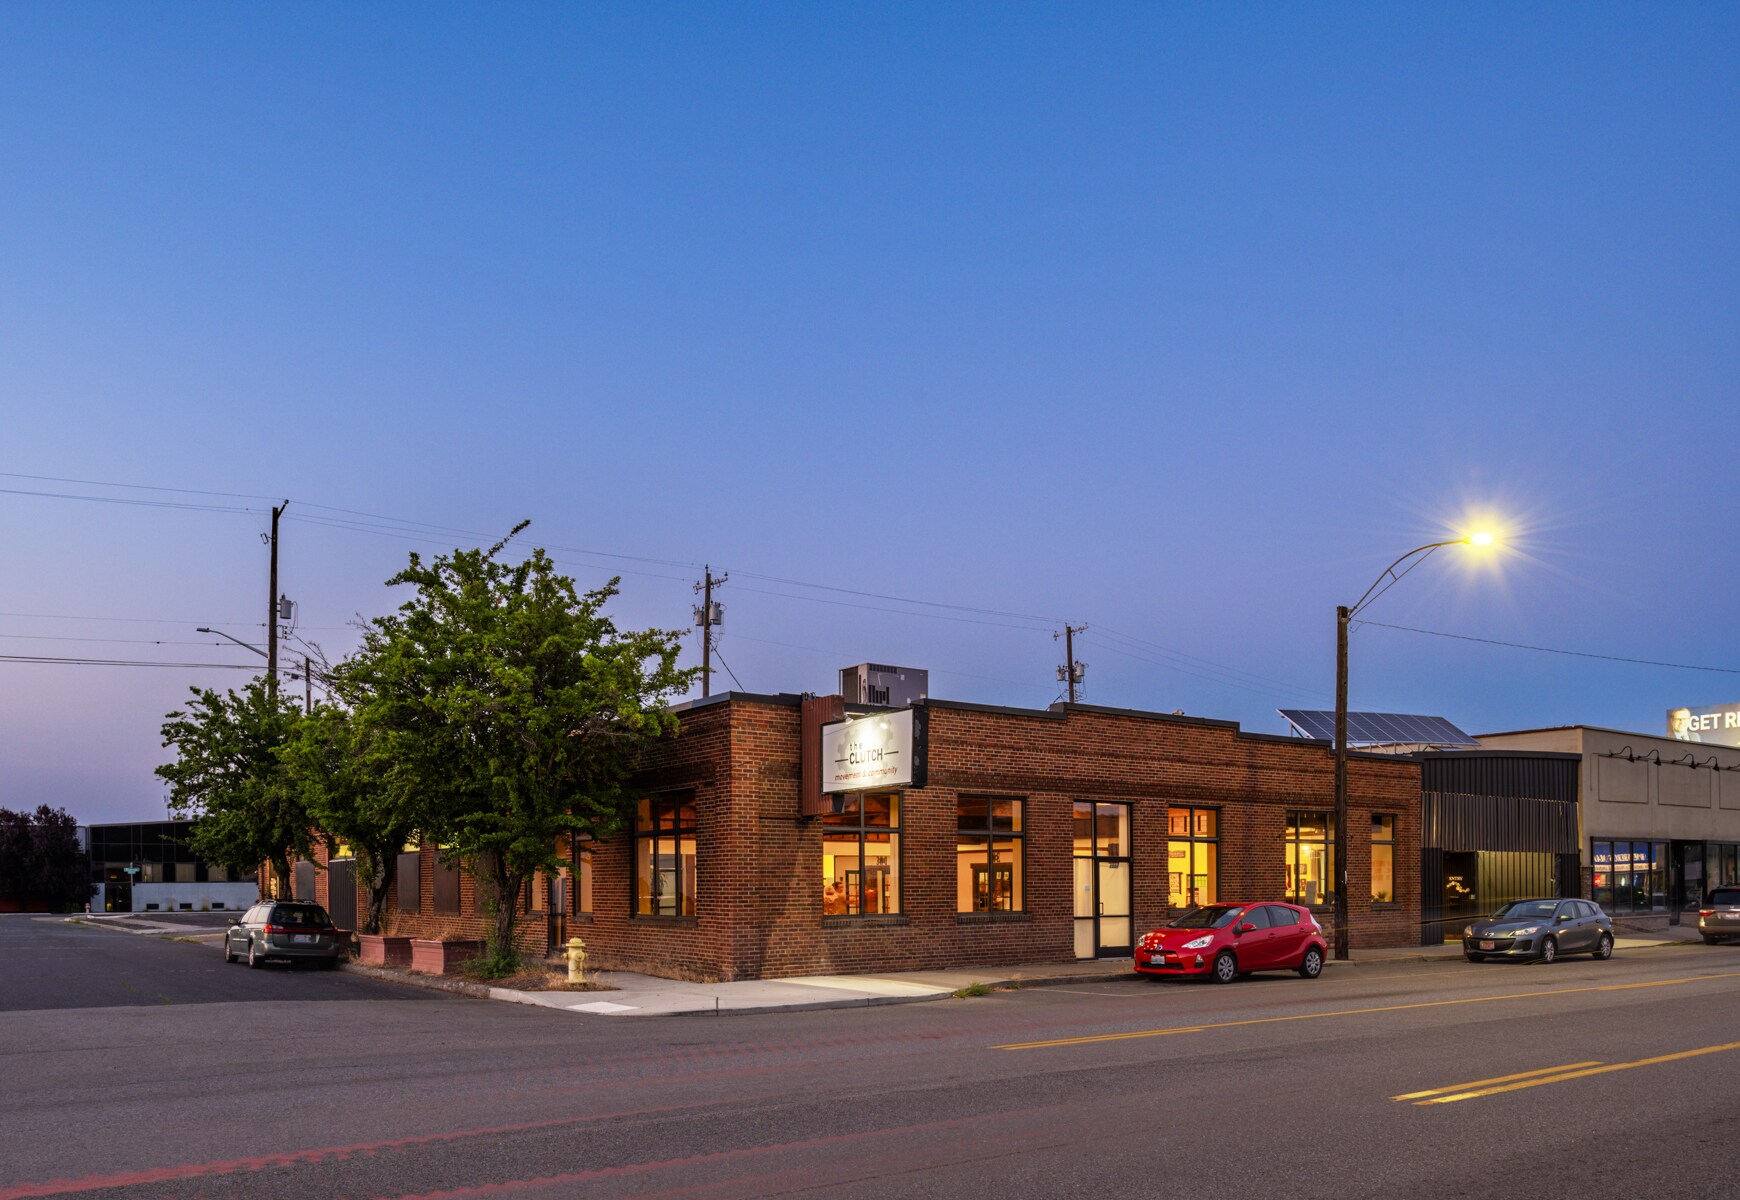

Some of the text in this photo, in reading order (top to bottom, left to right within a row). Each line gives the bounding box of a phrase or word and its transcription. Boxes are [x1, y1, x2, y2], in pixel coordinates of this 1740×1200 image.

[1688, 713, 1721, 731] GET
[849, 741, 862, 751] the
[849, 747, 883, 765] CLUTCH
[834, 771, 861, 781] movement
[868, 766, 898, 776] community
